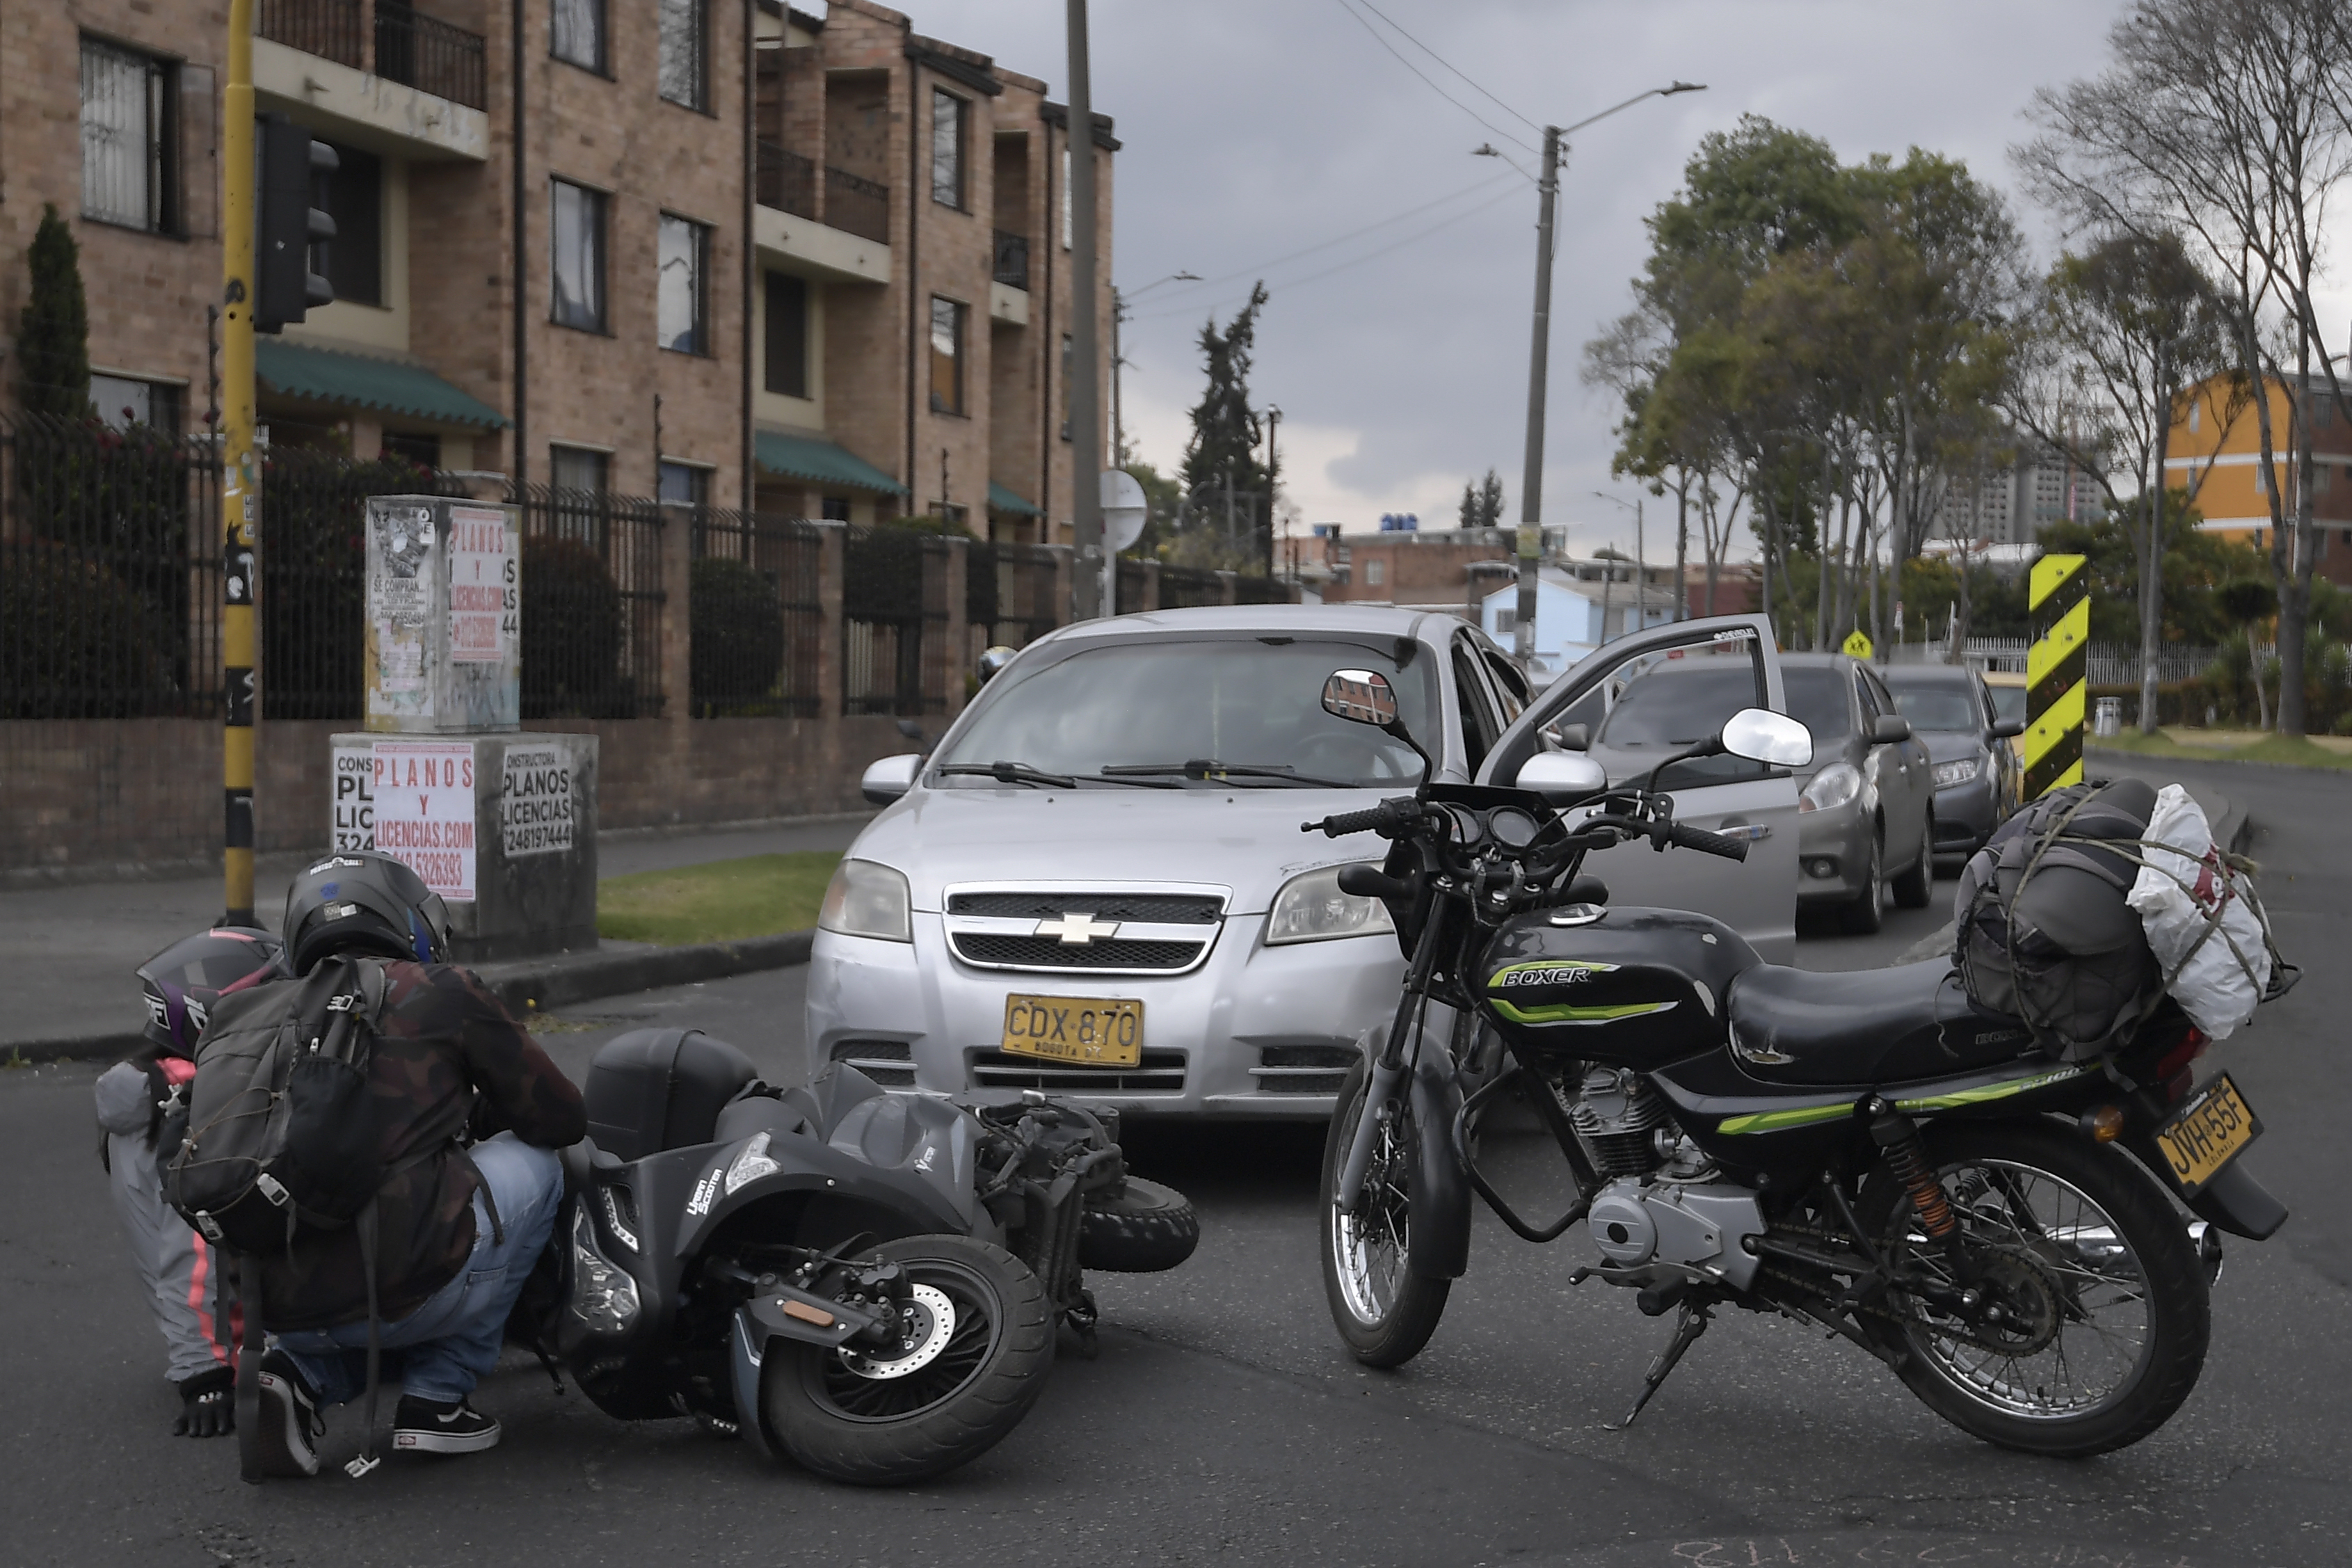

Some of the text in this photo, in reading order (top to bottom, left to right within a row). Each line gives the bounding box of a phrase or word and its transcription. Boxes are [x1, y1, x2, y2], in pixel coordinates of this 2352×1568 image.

[454, 523, 504, 553] PLANOS
[475, 560, 481, 579] Y
[338, 756, 373, 771] CONS
[374, 758, 473, 787] PLANOS
[337, 775, 374, 801] PL
[504, 769, 569, 797] PLANOS
[337, 805, 374, 829] LIC
[419, 794, 429, 815] Y
[502, 799, 570, 825] LICENCIAS
[375, 820, 473, 849] LICENCIAS.COM
[1501, 967, 1591, 987] BOXER
[1009, 1006, 1137, 1047] CDX 870
[2170, 1118, 2215, 1174] JVH
[2202, 1086, 2242, 1140] 55F
[698, 1169, 723, 1215] SCOOTER
